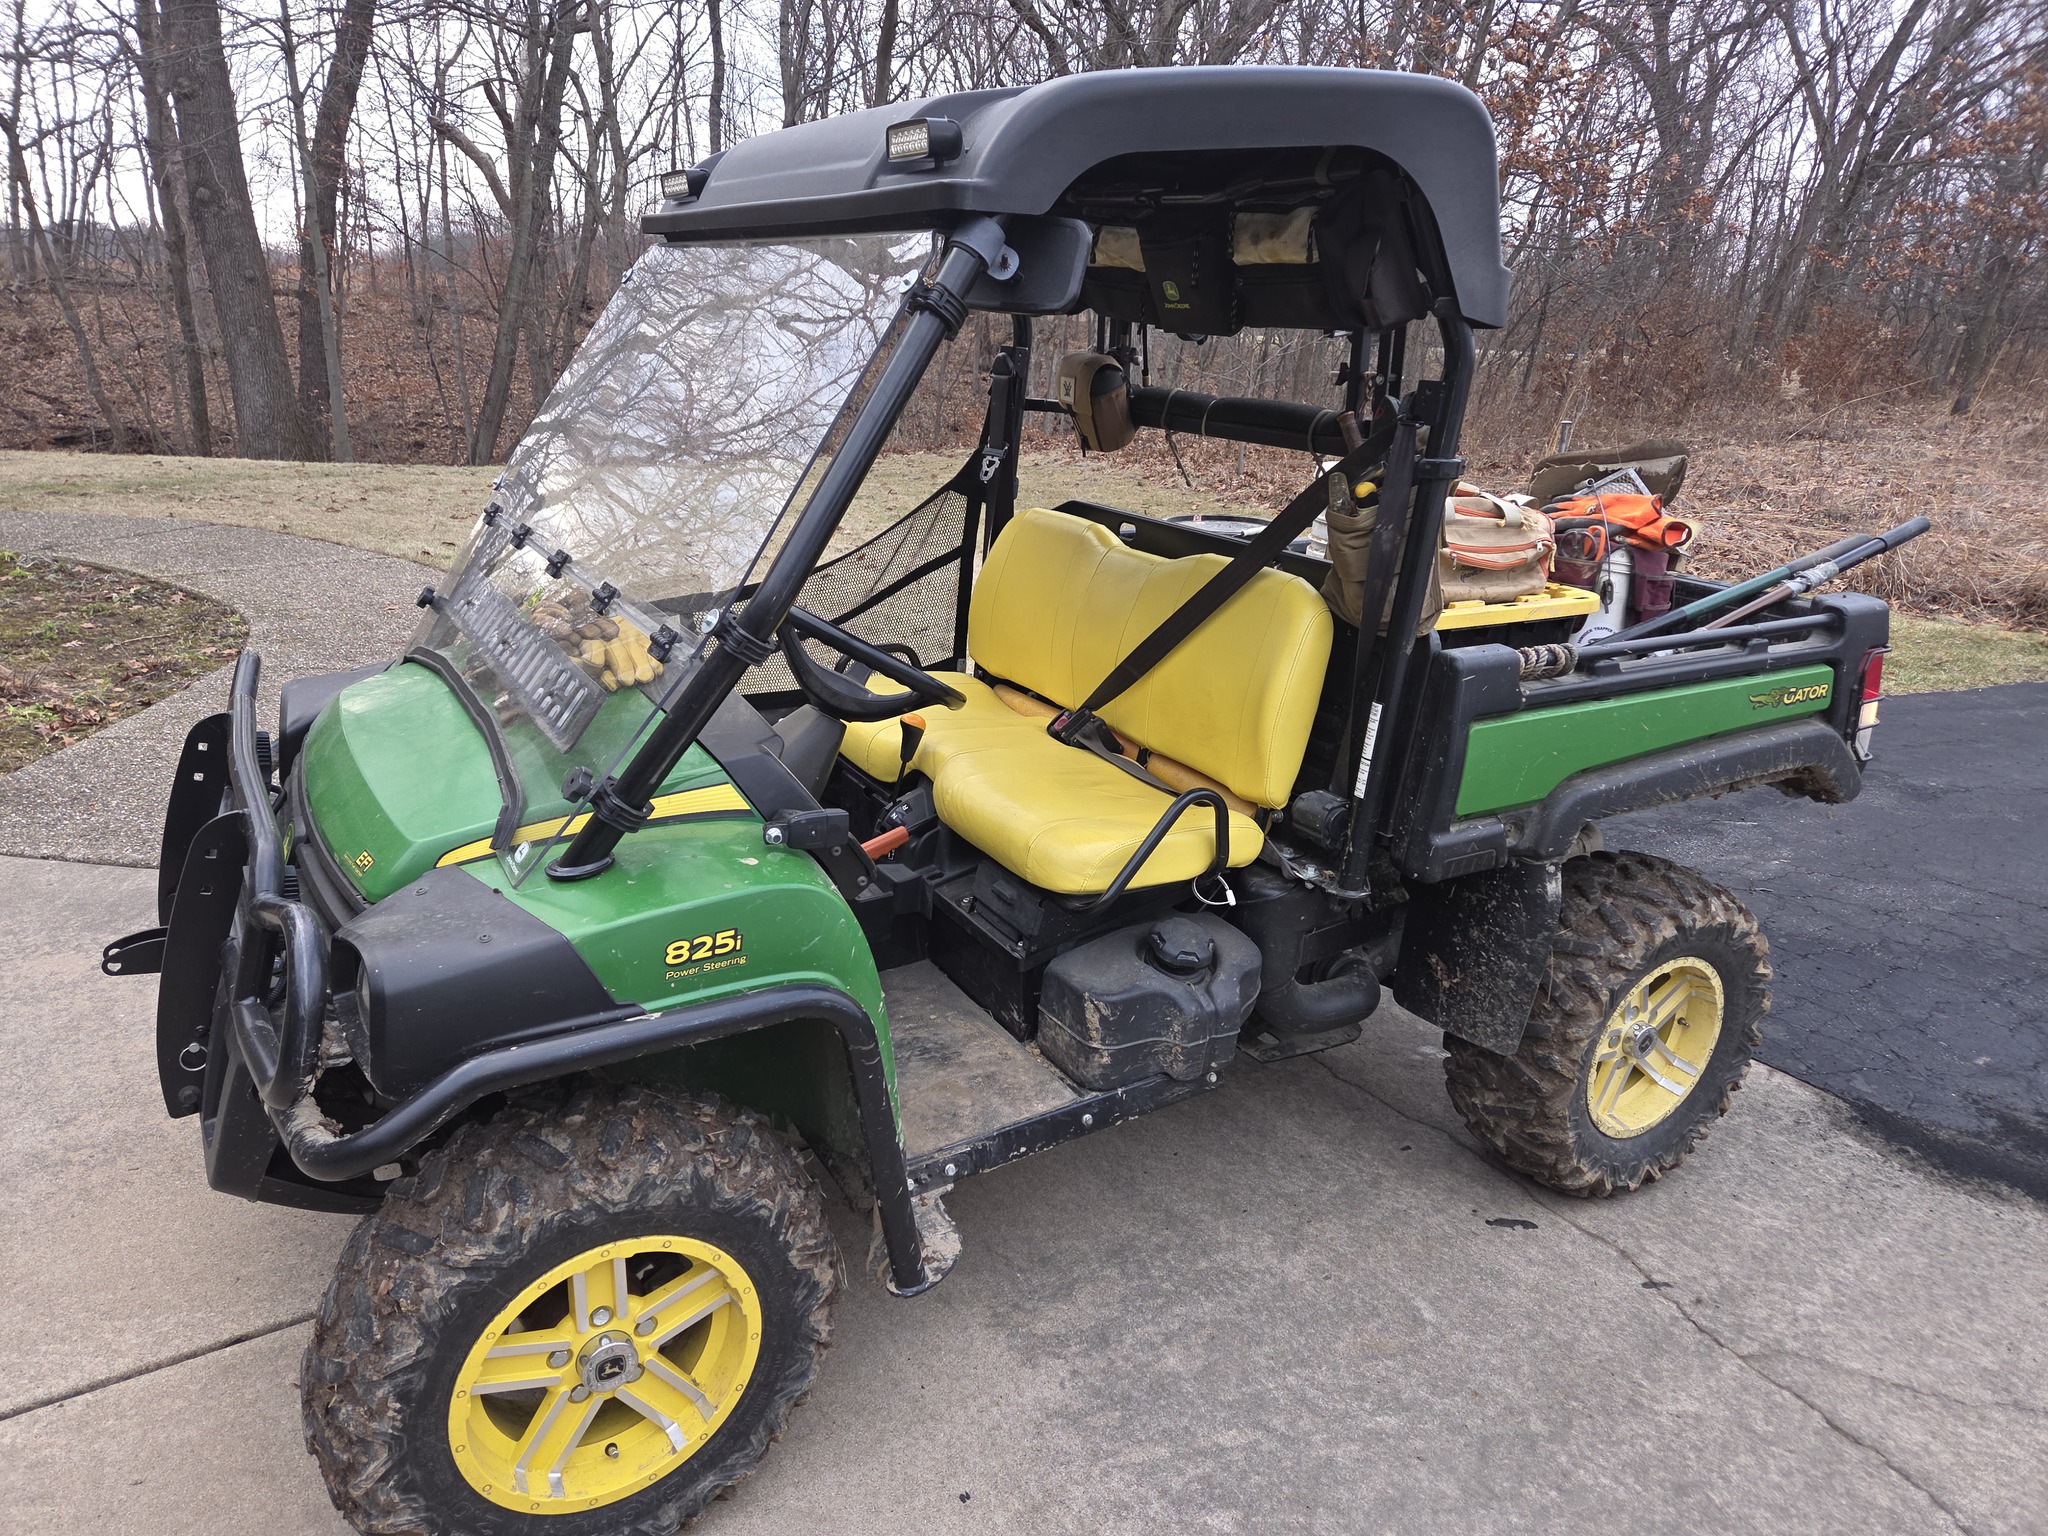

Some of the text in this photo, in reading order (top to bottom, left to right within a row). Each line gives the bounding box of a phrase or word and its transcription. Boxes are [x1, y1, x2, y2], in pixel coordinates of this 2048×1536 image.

[1783, 684, 1829, 704] GATOR
[891, 812, 898, 820] N
[355, 851, 374, 872] EFI
[665, 929, 742, 965] 825i
[665, 956, 747, 980] Power Steering
